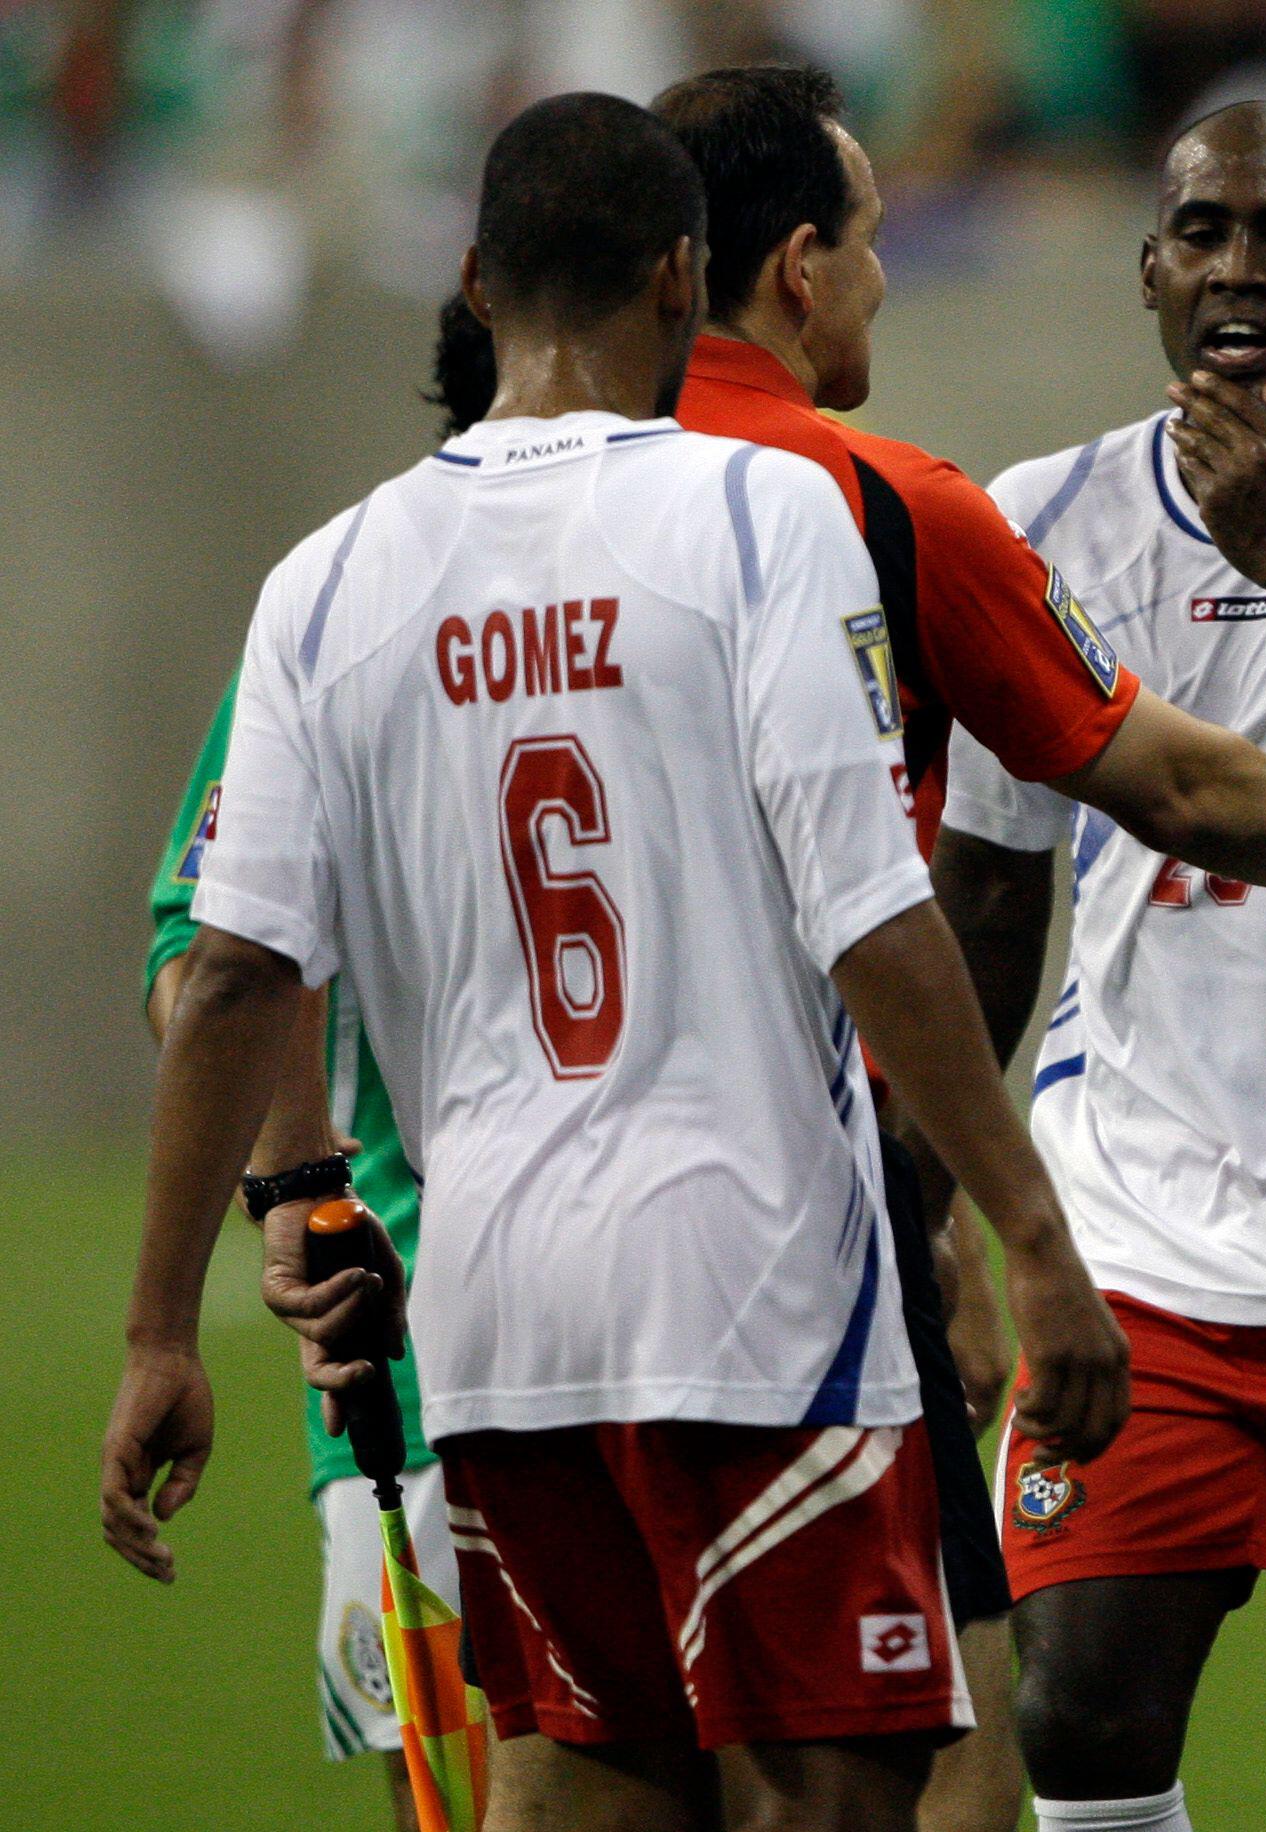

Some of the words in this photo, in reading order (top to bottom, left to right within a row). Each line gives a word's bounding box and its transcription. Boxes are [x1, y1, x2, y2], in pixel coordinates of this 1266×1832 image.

[505, 436, 585, 465] PANAMA
[436, 597, 623, 709] GOMEZ
[498, 732, 627, 1081] 6
